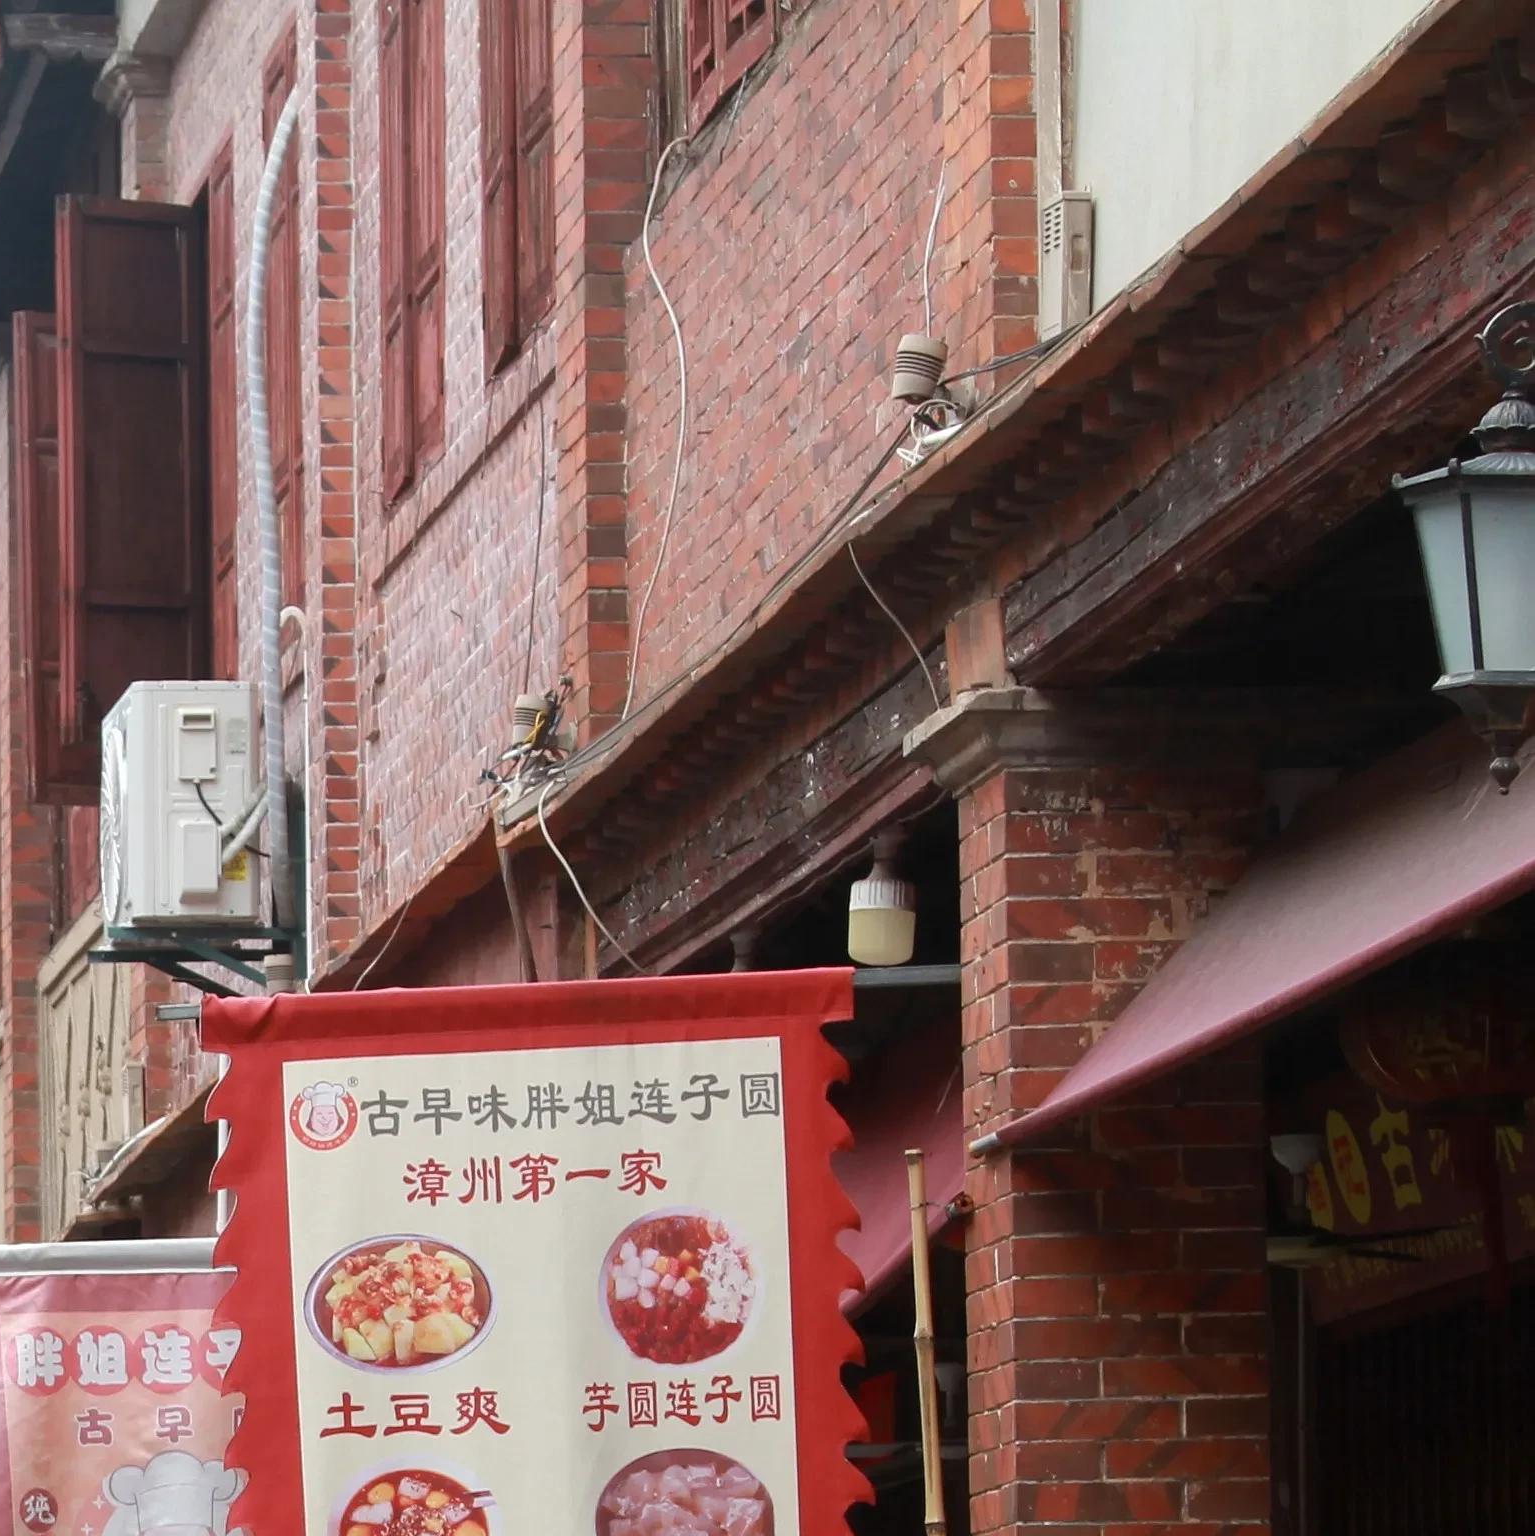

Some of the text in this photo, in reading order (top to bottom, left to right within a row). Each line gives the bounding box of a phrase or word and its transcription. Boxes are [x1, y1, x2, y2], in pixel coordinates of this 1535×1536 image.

[361, 1072, 780, 1137] 古早味胖姐连子圆
[402, 1149, 668, 1206] 漳州第一家
[76, 1407, 245, 1446] 古早
[319, 1386, 511, 1439] 土豆爽
[582, 1375, 780, 1432] 芋圆连子圆
